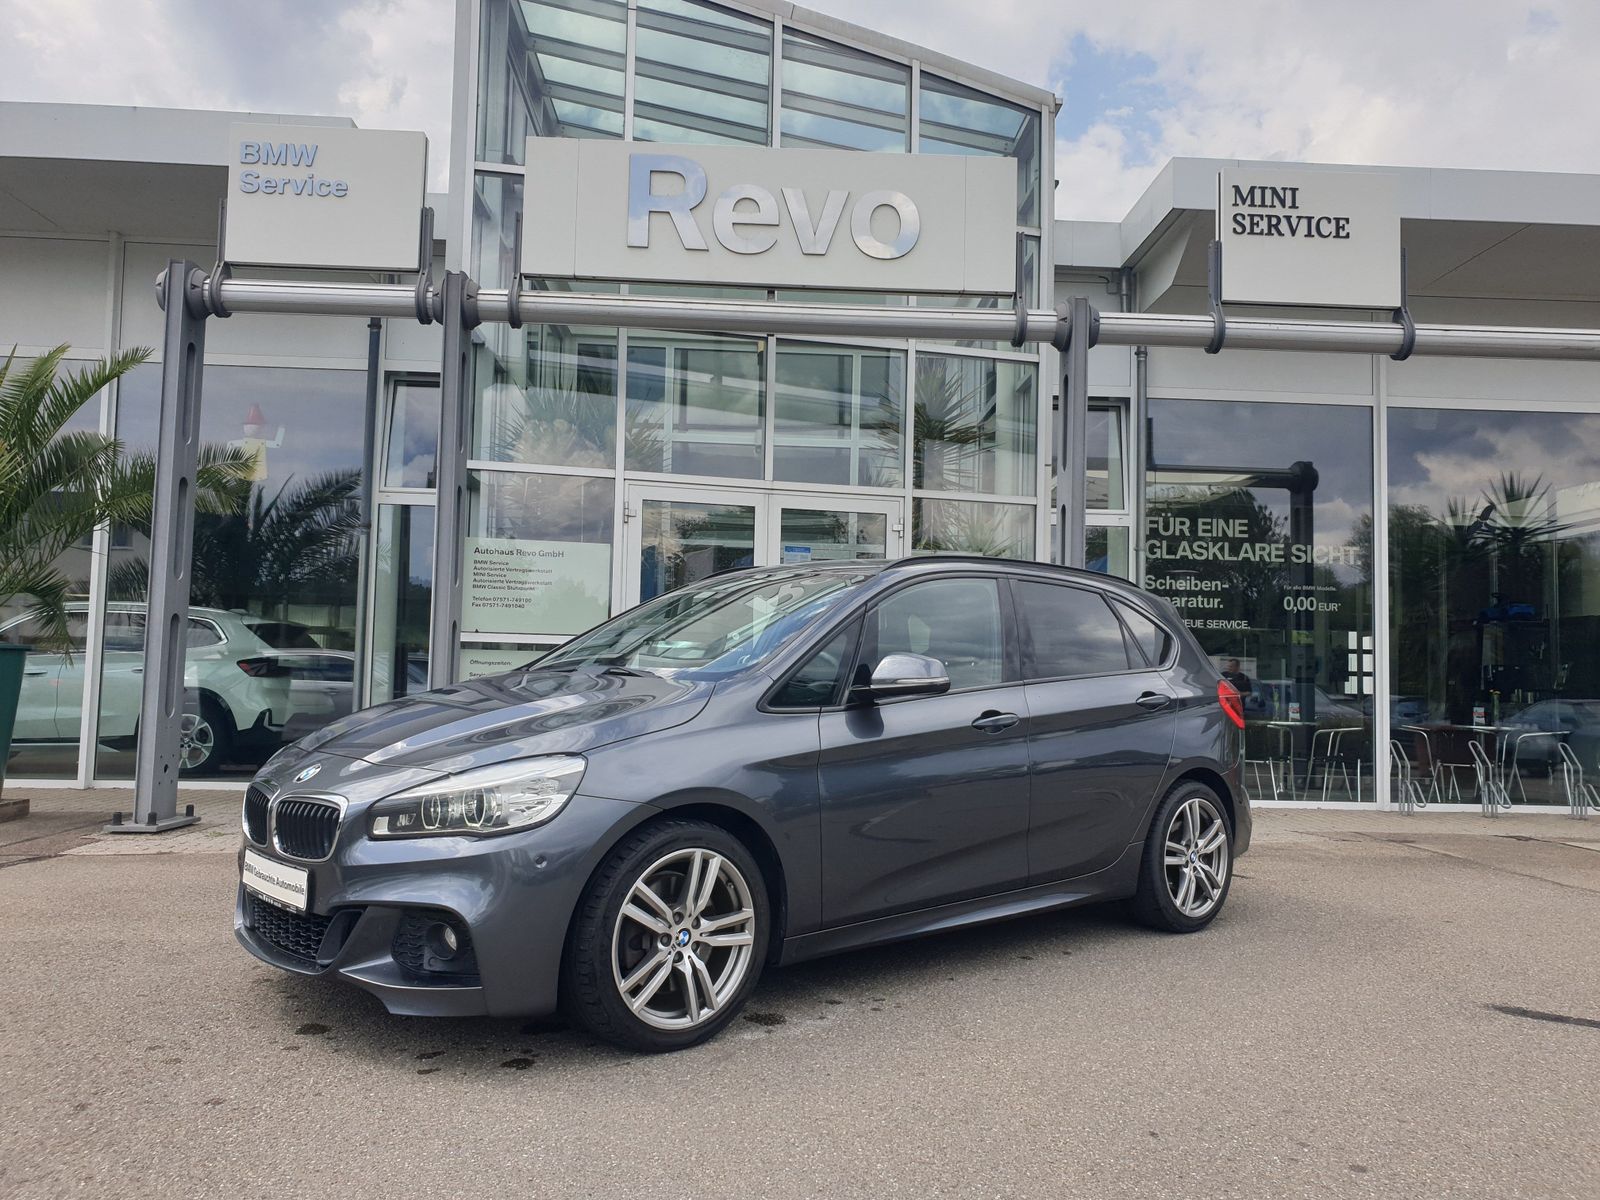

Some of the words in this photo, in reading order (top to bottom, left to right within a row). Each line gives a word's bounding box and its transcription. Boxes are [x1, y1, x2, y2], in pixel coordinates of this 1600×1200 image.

[239, 141, 319, 167] BMW
[239, 169, 349, 198] Service
[626, 153, 921, 261] Revo
[1231, 184, 1300, 210] MINI
[1232, 212, 1351, 240] SERVICE
[1145, 512, 1191, 537] FÜR
[1197, 517, 1249, 538] EINE
[473, 547, 515, 556] Autohaus
[516, 548, 537, 557] Revo
[538, 549, 565, 558] GmbH
[1145, 539, 1286, 563] GLASKLARE
[1145, 574, 1230, 592] Scheiben-
[1161, 594, 1224, 609] aratur.
[1283, 596, 1317, 614] 0,00
[1182, 618, 1204, 629] EUE
